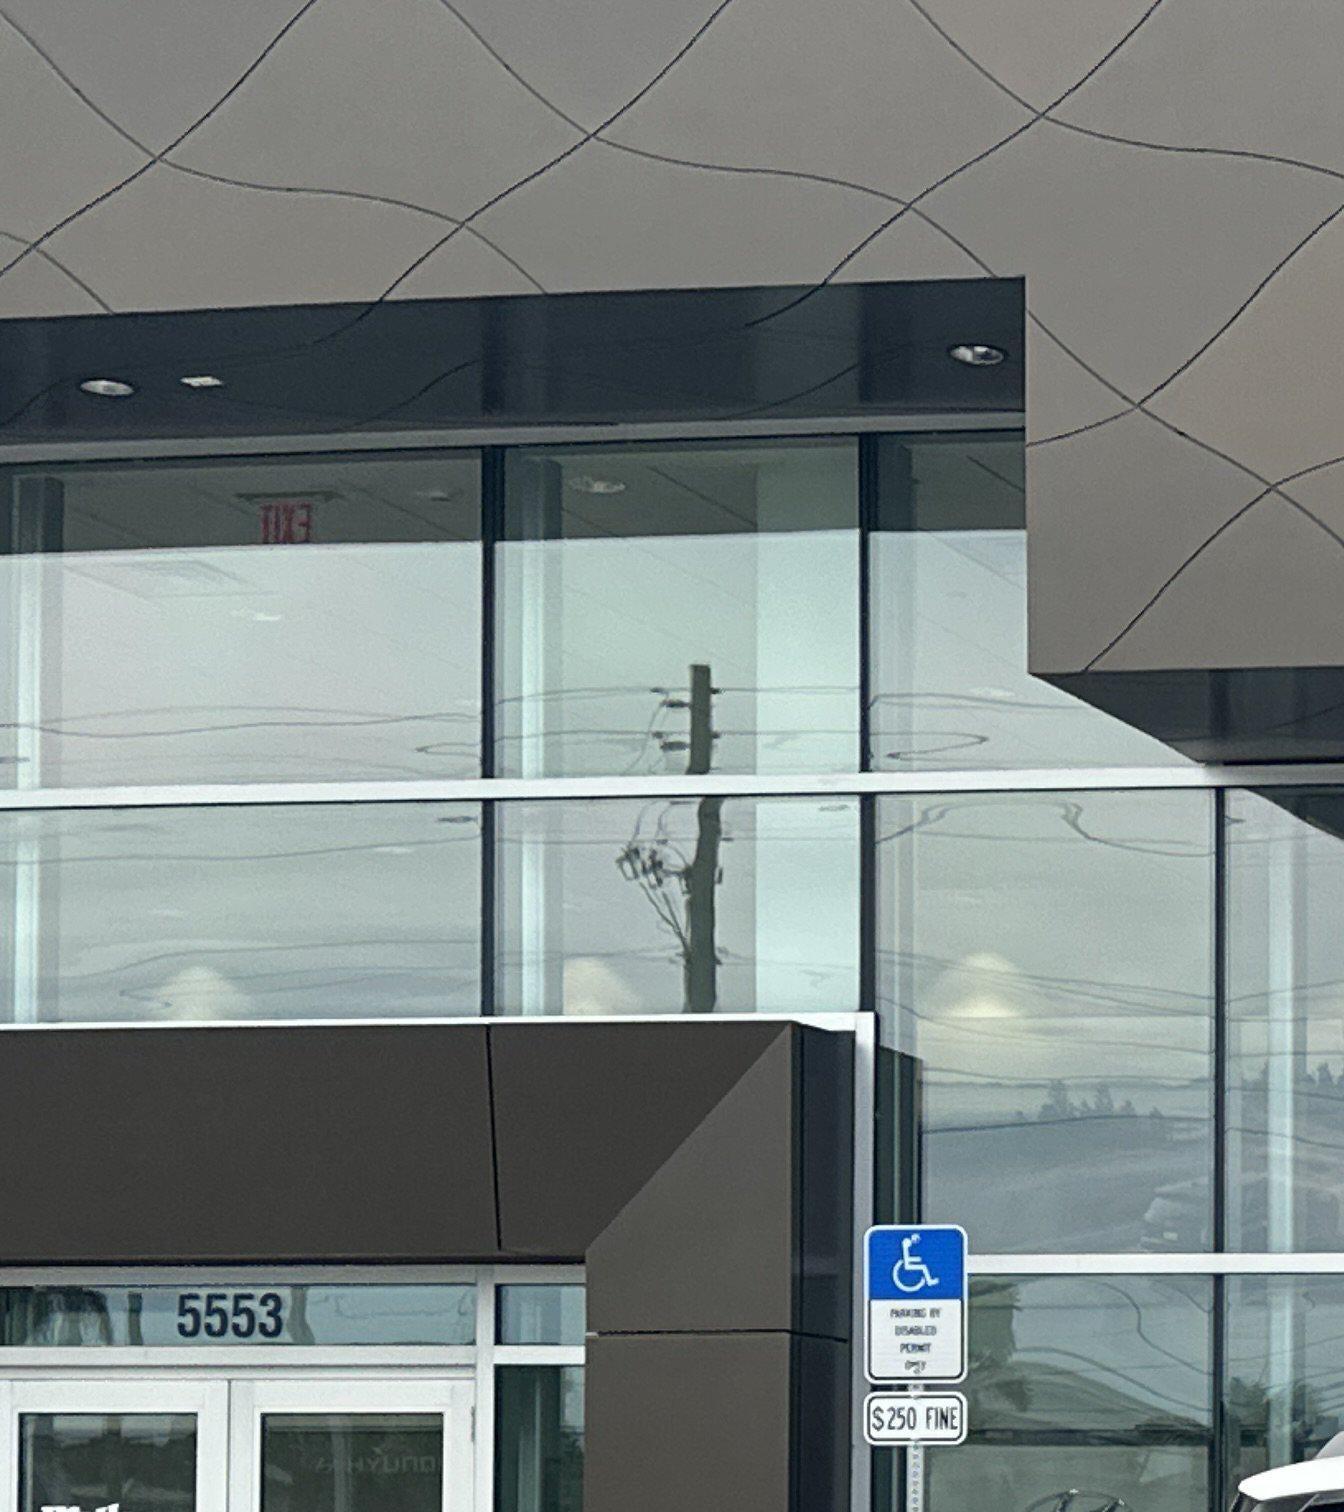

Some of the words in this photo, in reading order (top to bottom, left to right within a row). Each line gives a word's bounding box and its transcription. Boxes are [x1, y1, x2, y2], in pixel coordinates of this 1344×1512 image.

[177, 1292, 283, 1338] 5553
[873, 1406, 916, 1431] $250
[926, 1405, 958, 1430] FINE
